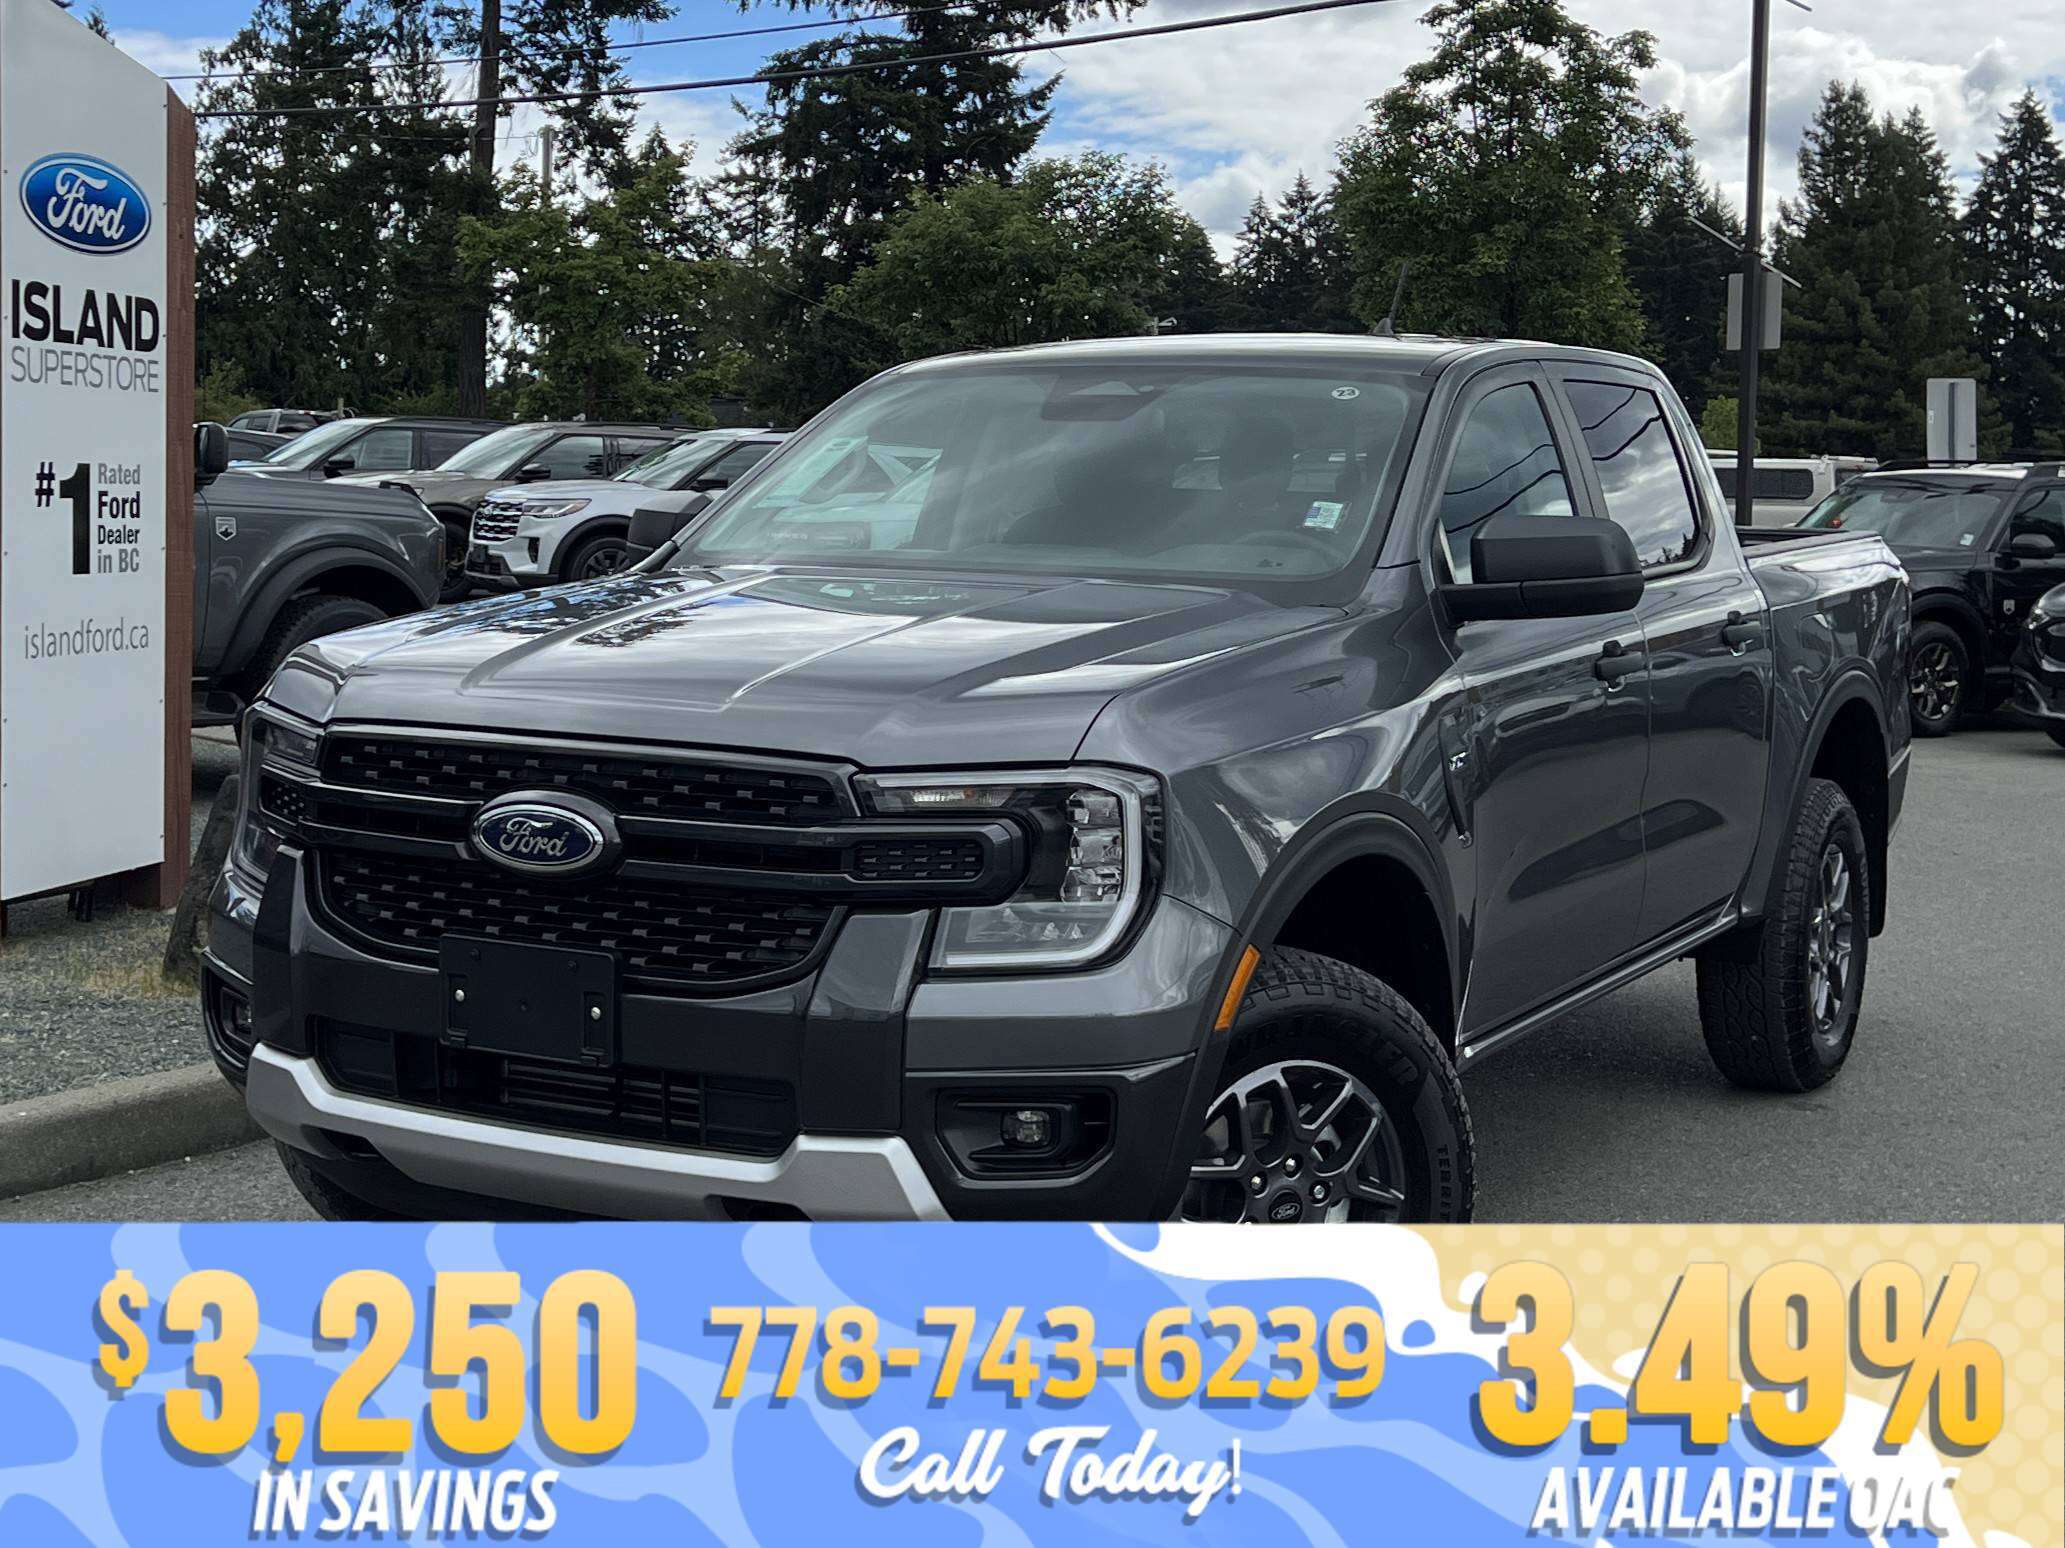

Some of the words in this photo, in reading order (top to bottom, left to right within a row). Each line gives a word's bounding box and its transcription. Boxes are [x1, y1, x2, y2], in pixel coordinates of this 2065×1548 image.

[47, 167, 128, 240] Ford
[11, 278, 160, 353] ISLAND
[11, 345, 160, 393] SUPERSTORE
[98, 462, 141, 485] Rated
[35, 461, 91, 575] #1
[98, 490, 141, 519] Ford
[98, 524, 141, 545] Dealer
[97, 549, 113, 574] in
[118, 548, 140, 573] BC
[24, 616, 149, 660] islandford.ca
[499, 816, 571, 858] Ford
